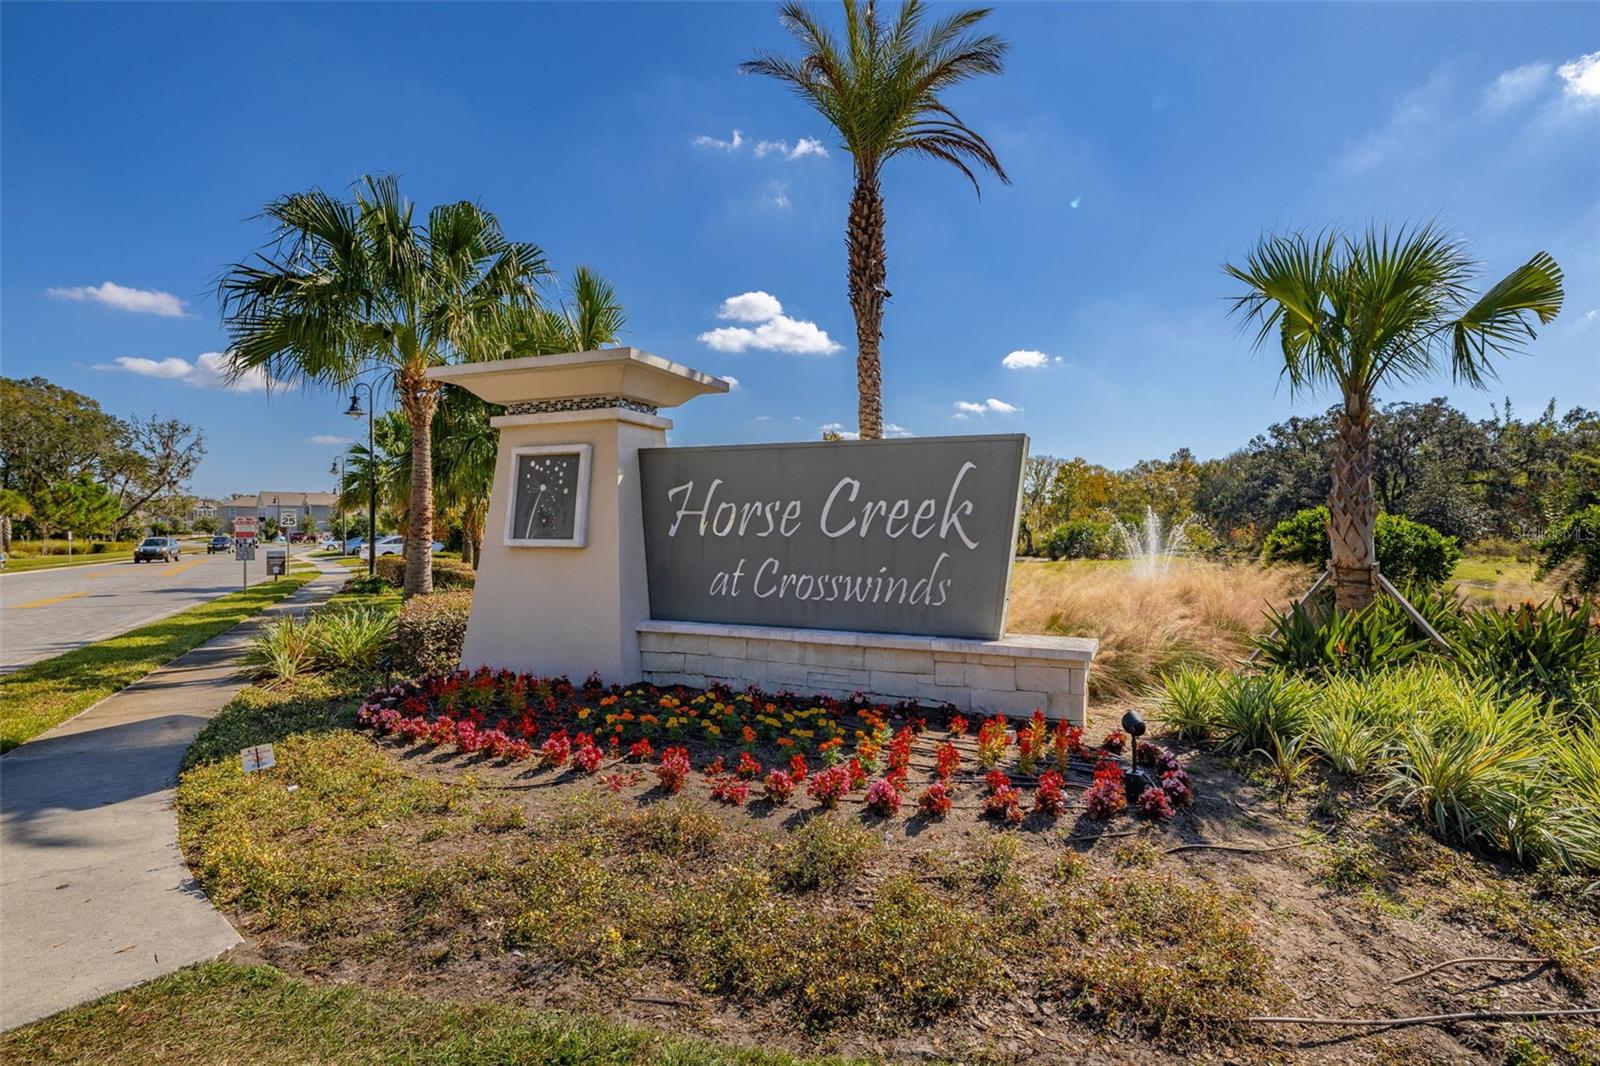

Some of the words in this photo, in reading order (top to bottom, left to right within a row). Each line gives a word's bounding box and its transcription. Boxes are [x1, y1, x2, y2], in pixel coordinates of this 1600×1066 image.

[282, 517, 296, 525] 25
[667, 479, 801, 538] Horse
[820, 461, 980, 550] Creek
[708, 557, 746, 597] at
[753, 552, 952, 607] Crosswinds
